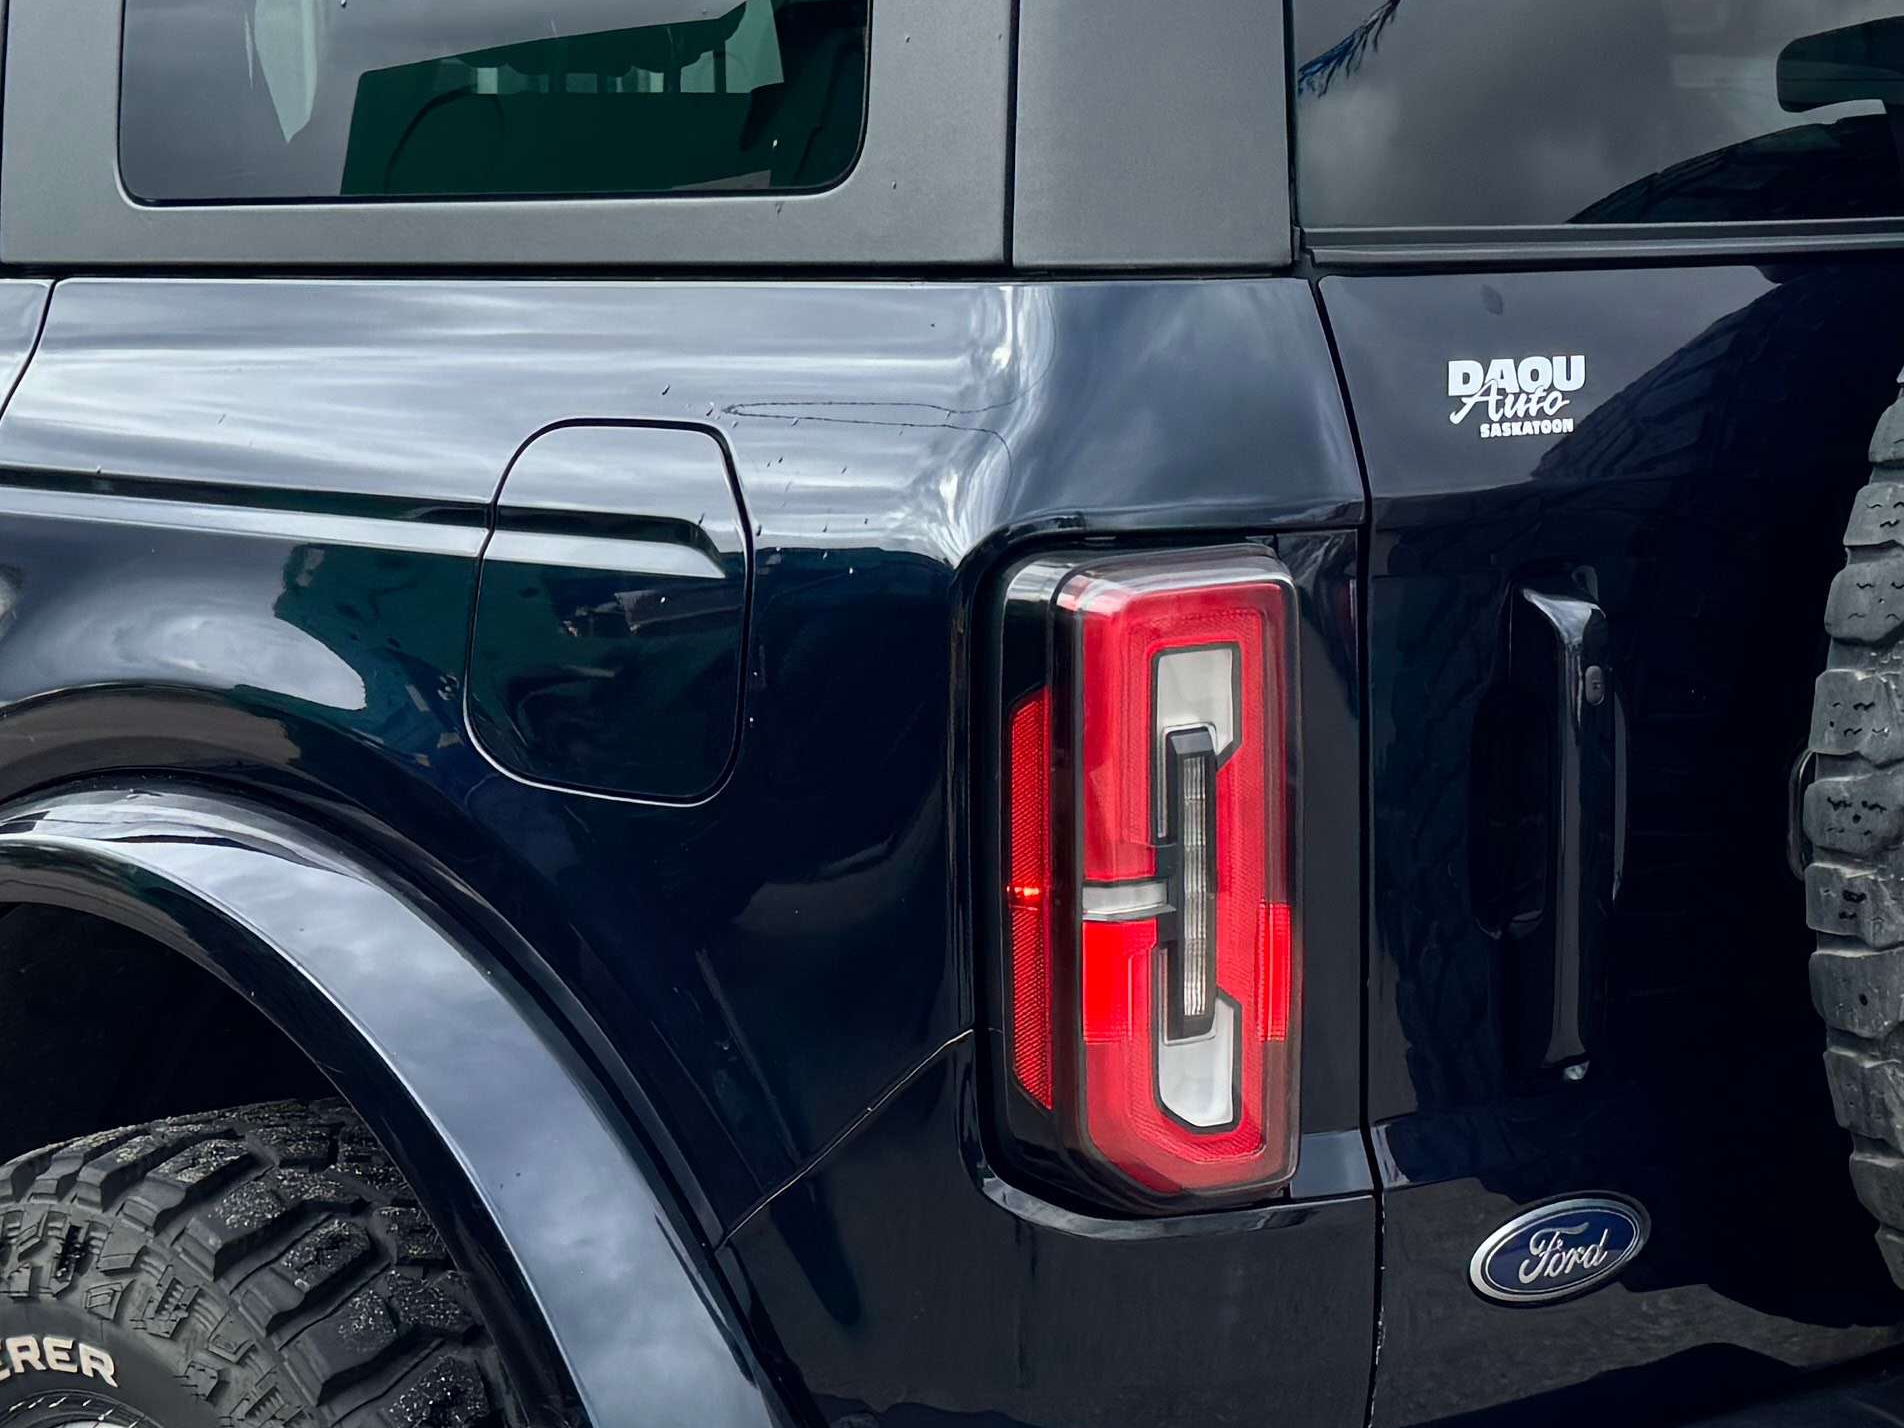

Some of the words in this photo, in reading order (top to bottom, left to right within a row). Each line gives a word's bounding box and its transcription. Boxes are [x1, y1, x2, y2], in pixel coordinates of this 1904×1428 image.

[1448, 355, 1586, 396] DAOU
[1450, 378, 1570, 424] Auto
[1480, 419, 1574, 438] SASKATOON
[1518, 1222, 1609, 1284] Ford
